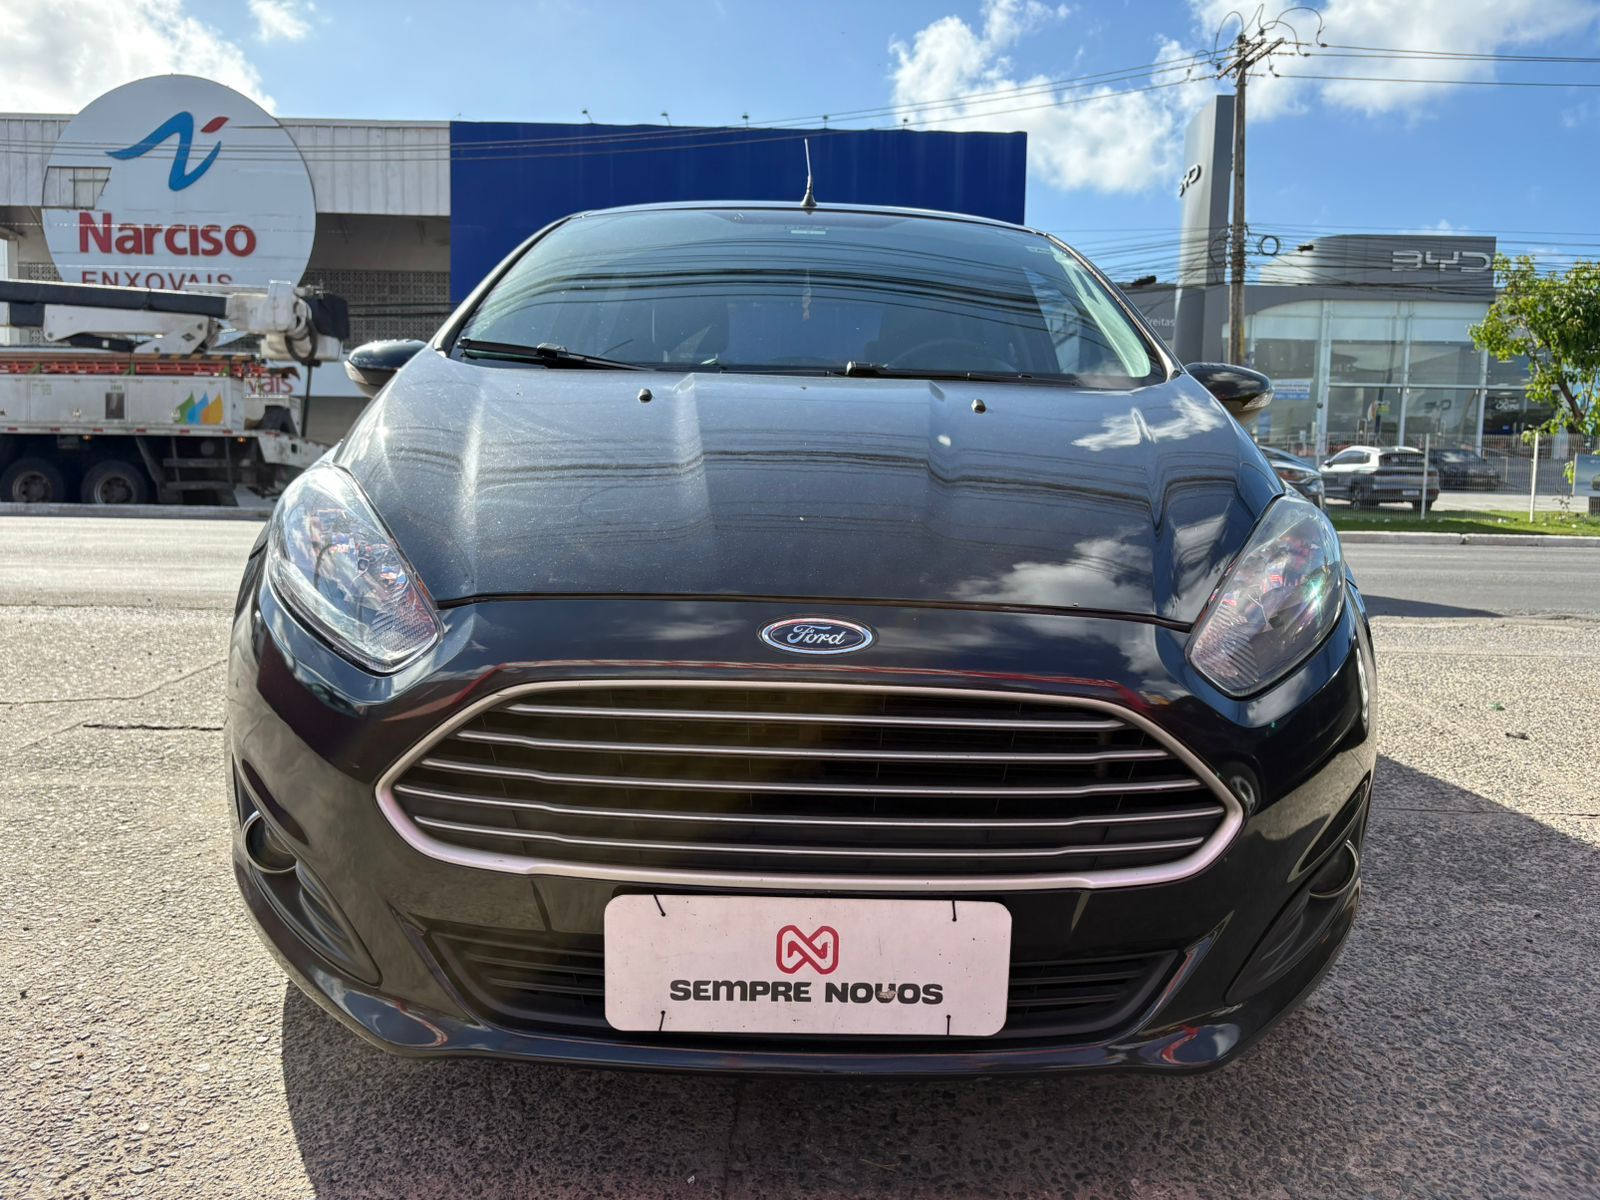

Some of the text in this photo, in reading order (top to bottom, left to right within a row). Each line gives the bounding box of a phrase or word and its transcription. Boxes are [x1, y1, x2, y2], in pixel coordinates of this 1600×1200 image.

[79, 212, 257, 257] Narciso
[1392, 250, 1491, 272] BYD
[786, 624, 847, 645] Ford
[669, 979, 812, 1003] SEMPRE
